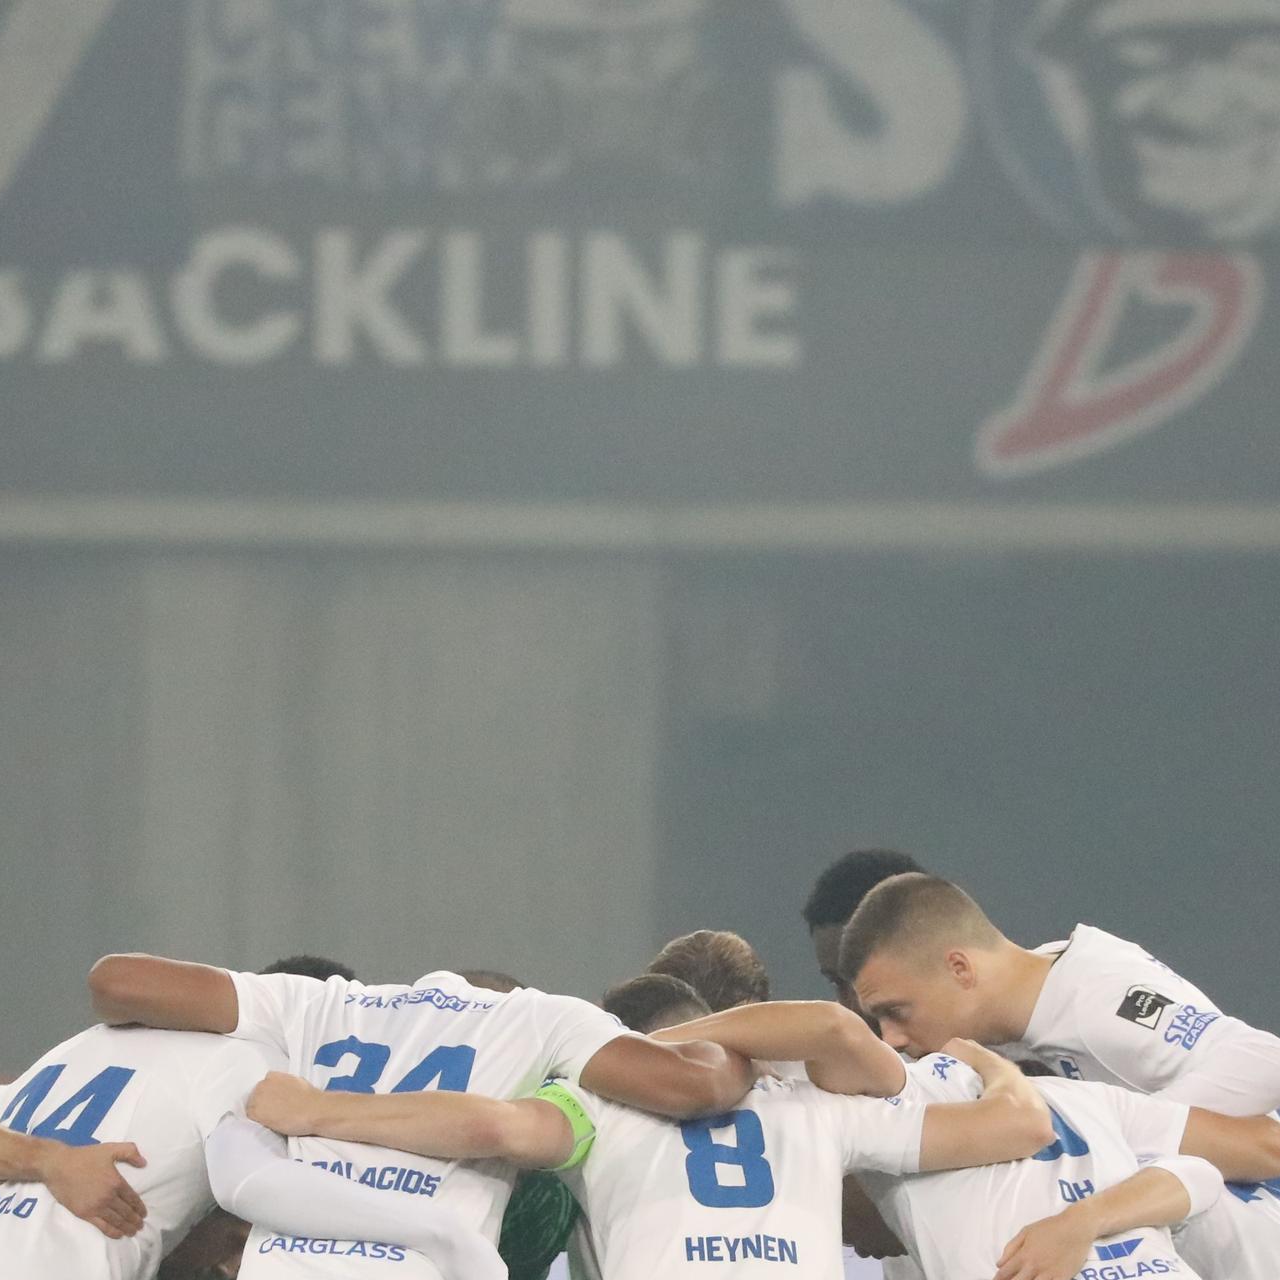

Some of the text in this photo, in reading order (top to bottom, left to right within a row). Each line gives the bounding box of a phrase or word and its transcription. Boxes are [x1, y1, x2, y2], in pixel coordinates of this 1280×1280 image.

[314, 1035, 477, 1094] 34
[681, 1109, 775, 1208] 8
[684, 1234, 798, 1265] HEYNEN
